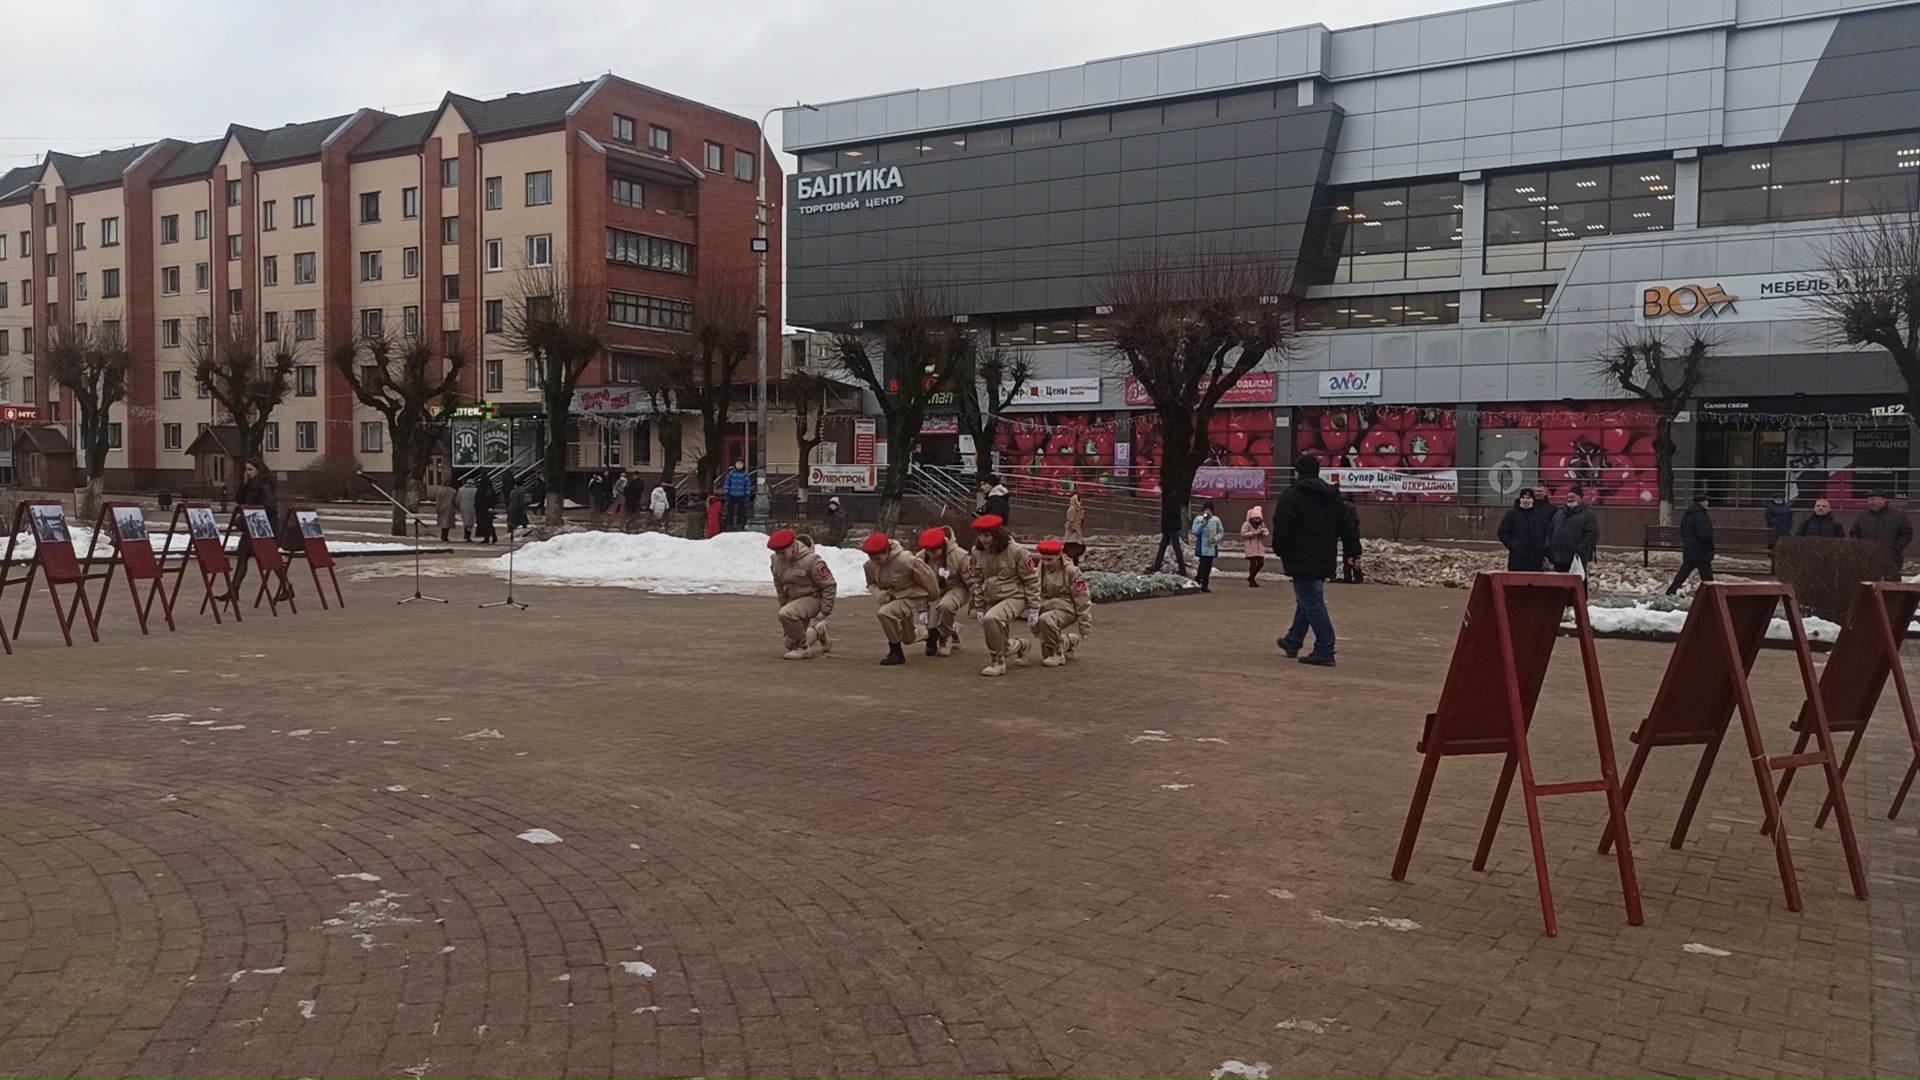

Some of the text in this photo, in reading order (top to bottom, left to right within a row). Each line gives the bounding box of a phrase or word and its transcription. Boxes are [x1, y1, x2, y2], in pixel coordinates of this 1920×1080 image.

[797, 166, 904, 200] БАЛТИКА
[799, 195, 905, 215] ТОРГОВЫЙ ЦЕНТР
[1760, 279, 1830, 294] МЕБЕЛЬ
[1836, 278, 1849, 290] И
[1046, 385, 1068, 397] Цены
[18, 411, 37, 419] МТС
[1871, 404, 1905, 417] TELE2
[459, 433, 474, 448] 10
[1855, 431, 1895, 440] ВМЕСТЕ
[1118, 444, 1125, 454] 2
[1855, 440, 1909, 449] ВЫГОДНЕЕ
[812, 468, 866, 484] ЭЛЕКТРОН
[1348, 472, 1401, 484] Супер Цены
[1226, 476, 1262, 489] SHOP
[1402, 481, 1455, 491] ОТКРЫЛИСЬ!
